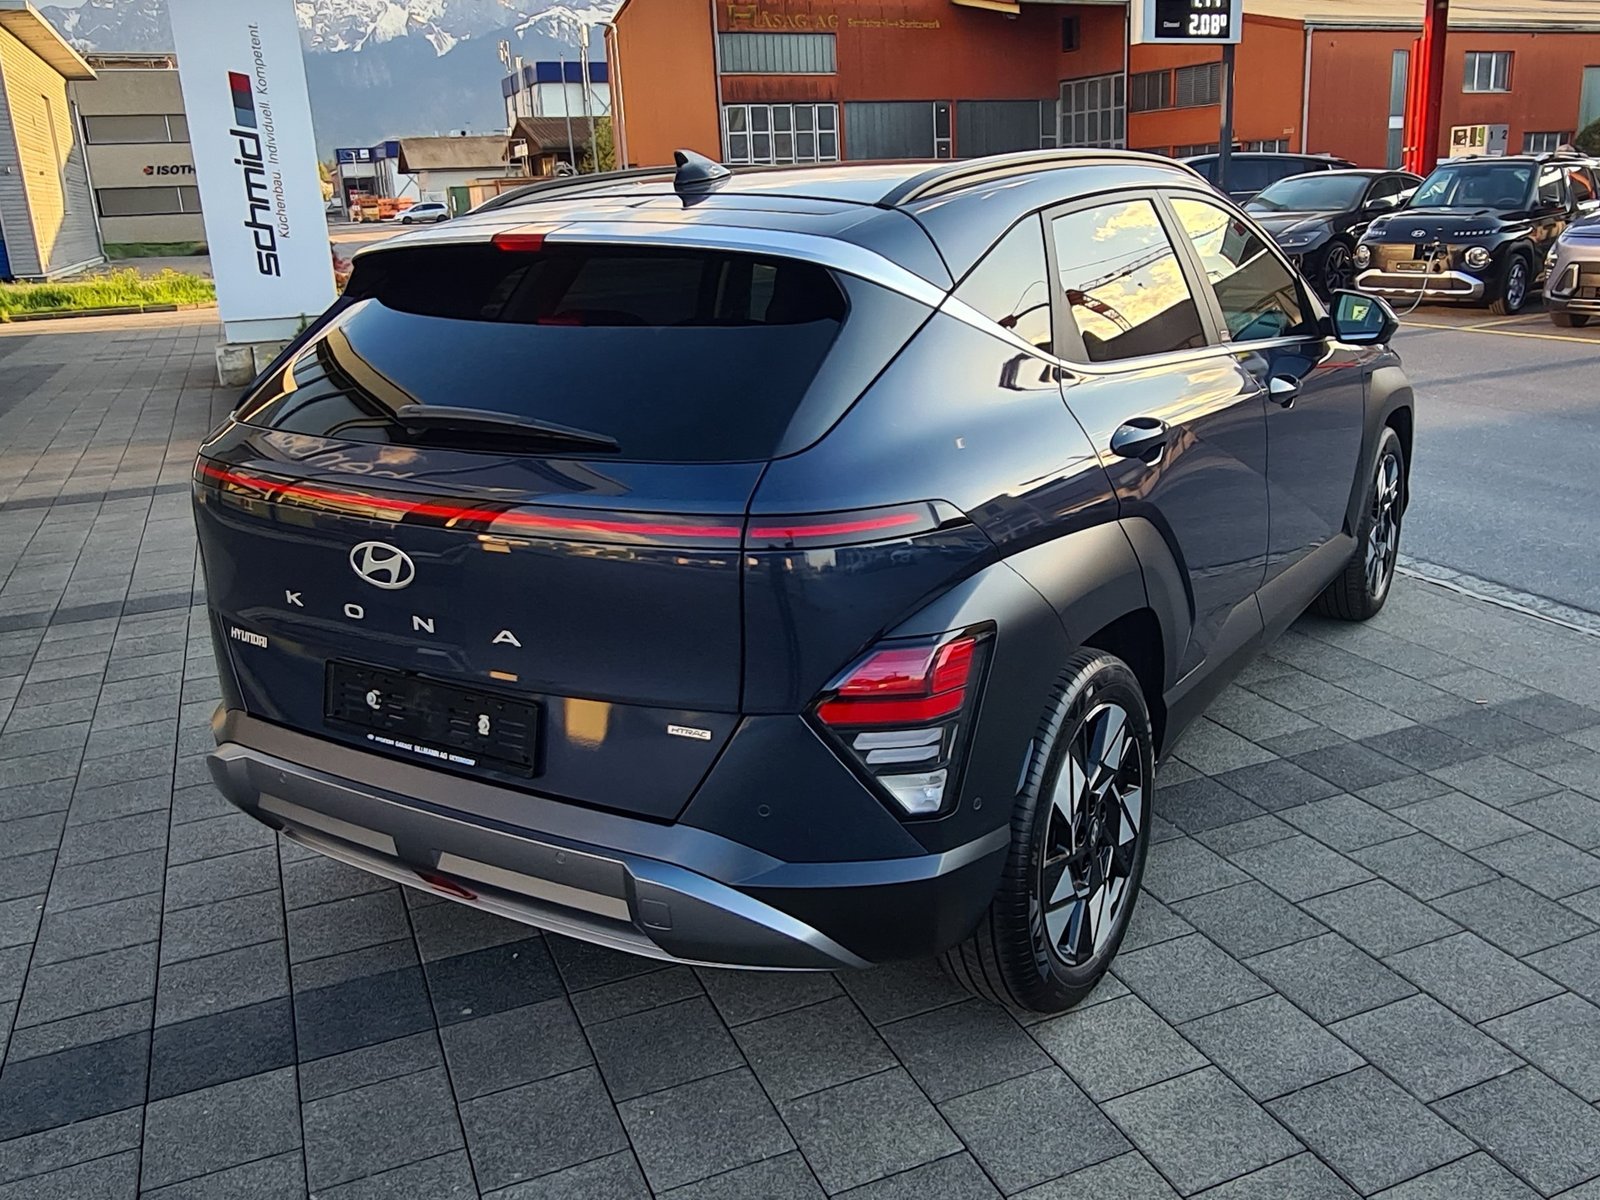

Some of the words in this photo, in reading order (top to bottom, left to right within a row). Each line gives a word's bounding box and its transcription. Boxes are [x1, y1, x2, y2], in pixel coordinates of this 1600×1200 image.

[248, 22, 268, 95] Kompetent.
[259, 100, 279, 165] Individuell.
[1501, 130, 1508, 140] 2
[229, 128, 281, 277] schmid
[272, 170, 290, 239] Küchenbau.
[231, 625, 268, 649] HYUNDAI
[285, 590, 522, 648] KONA
[671, 727, 708, 738] HTRAC
